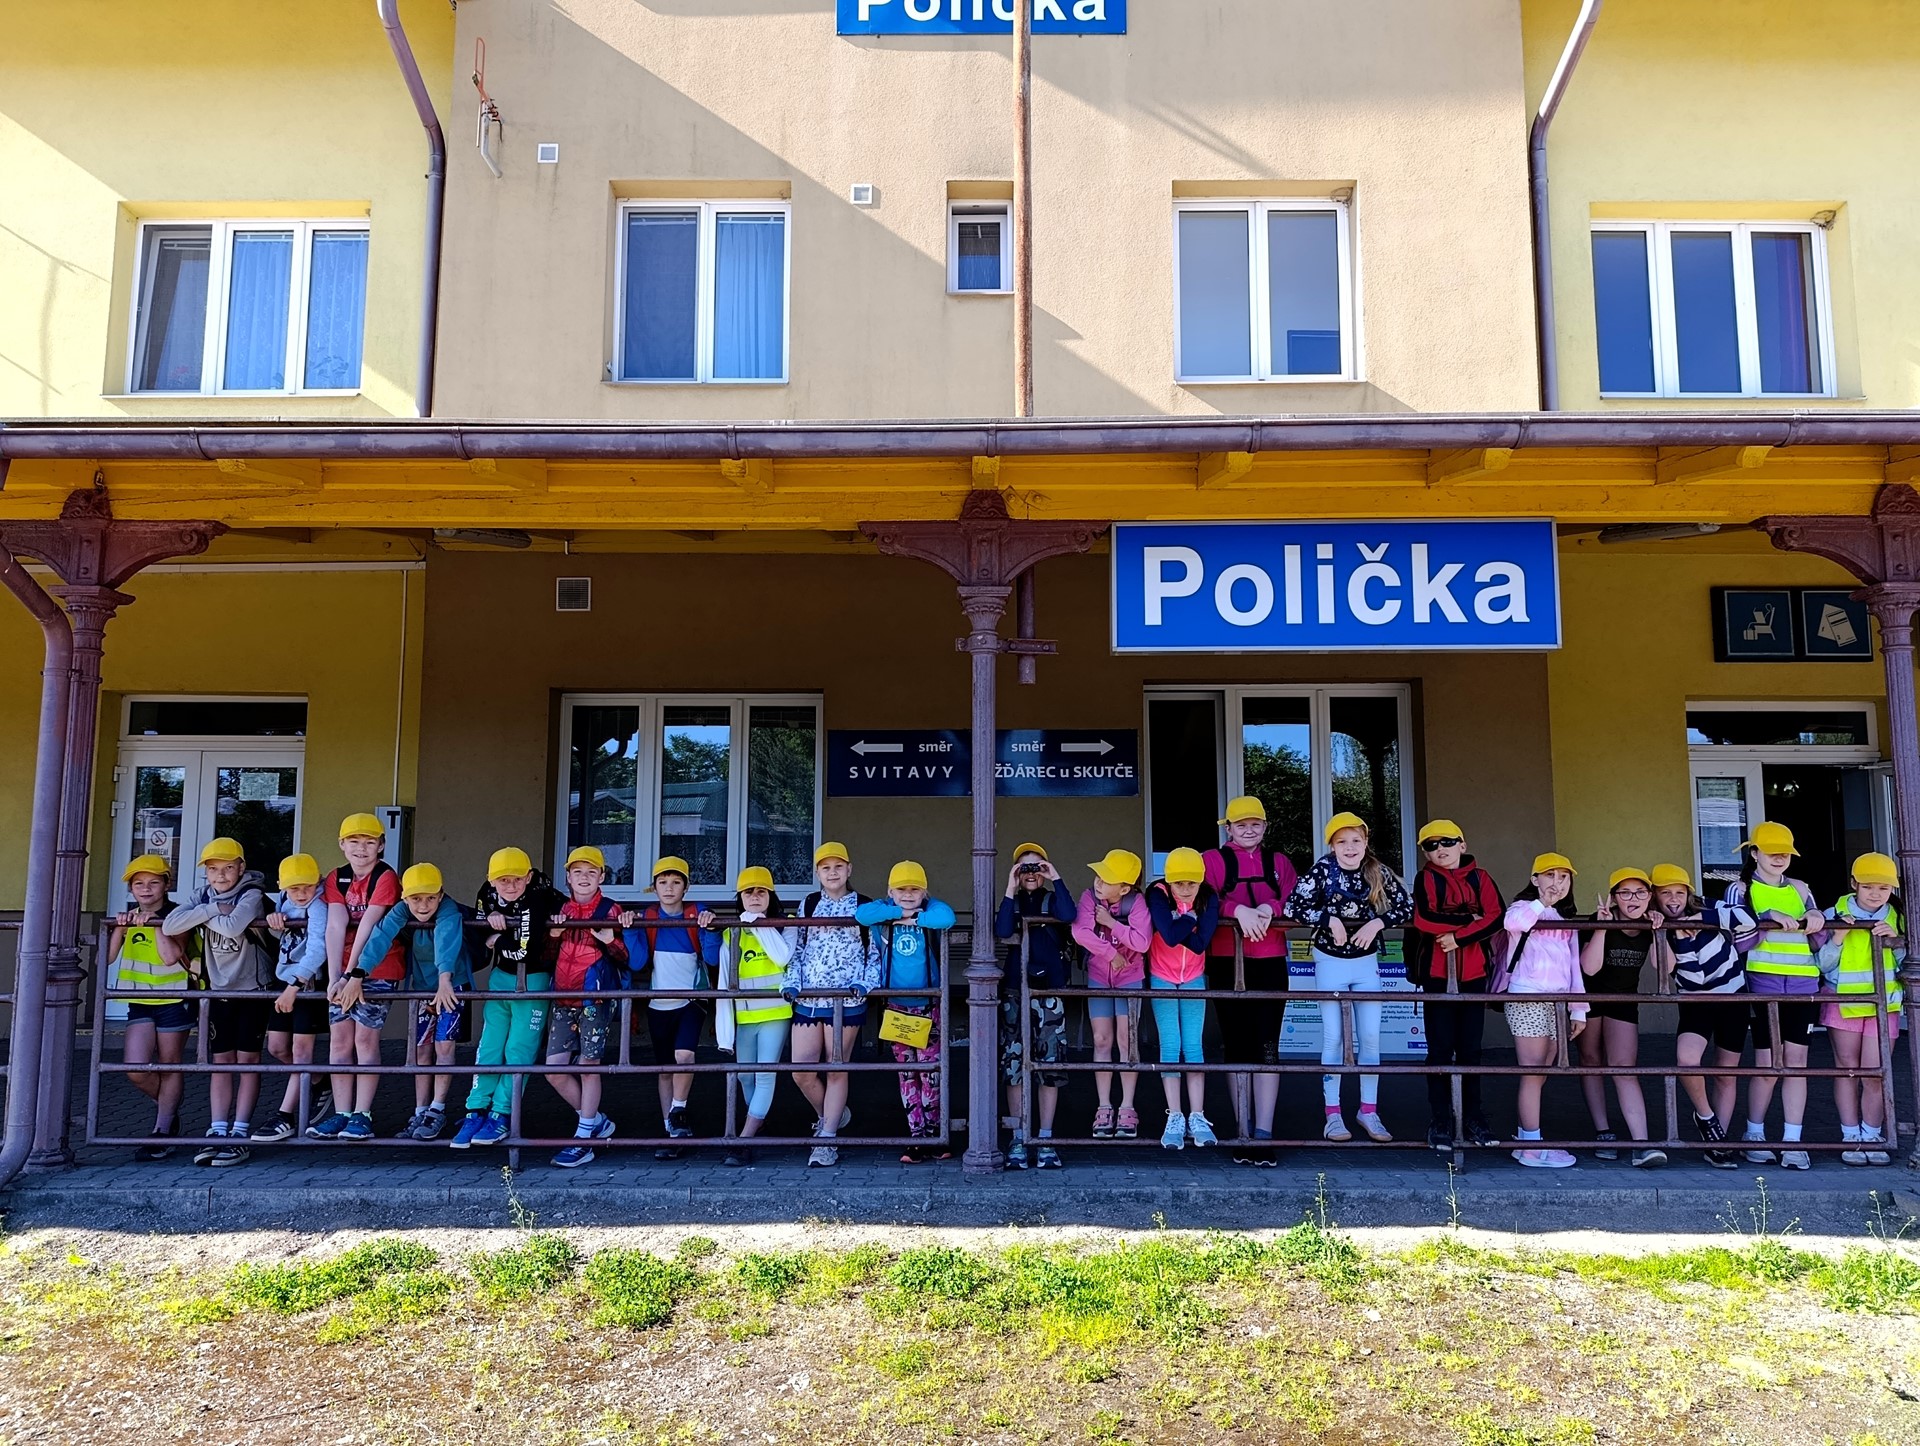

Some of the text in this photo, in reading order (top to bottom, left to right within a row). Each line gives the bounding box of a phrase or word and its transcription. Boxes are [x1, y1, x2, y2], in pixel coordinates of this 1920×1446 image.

[1143, 542, 1530, 626] Polička
[918, 740, 953, 752] směr
[1011, 740, 1046, 752] směr
[849, 766, 954, 779] SVITAVY
[1060, 767, 1069, 779] u
[1073, 762, 1134, 779] SKUTČE
